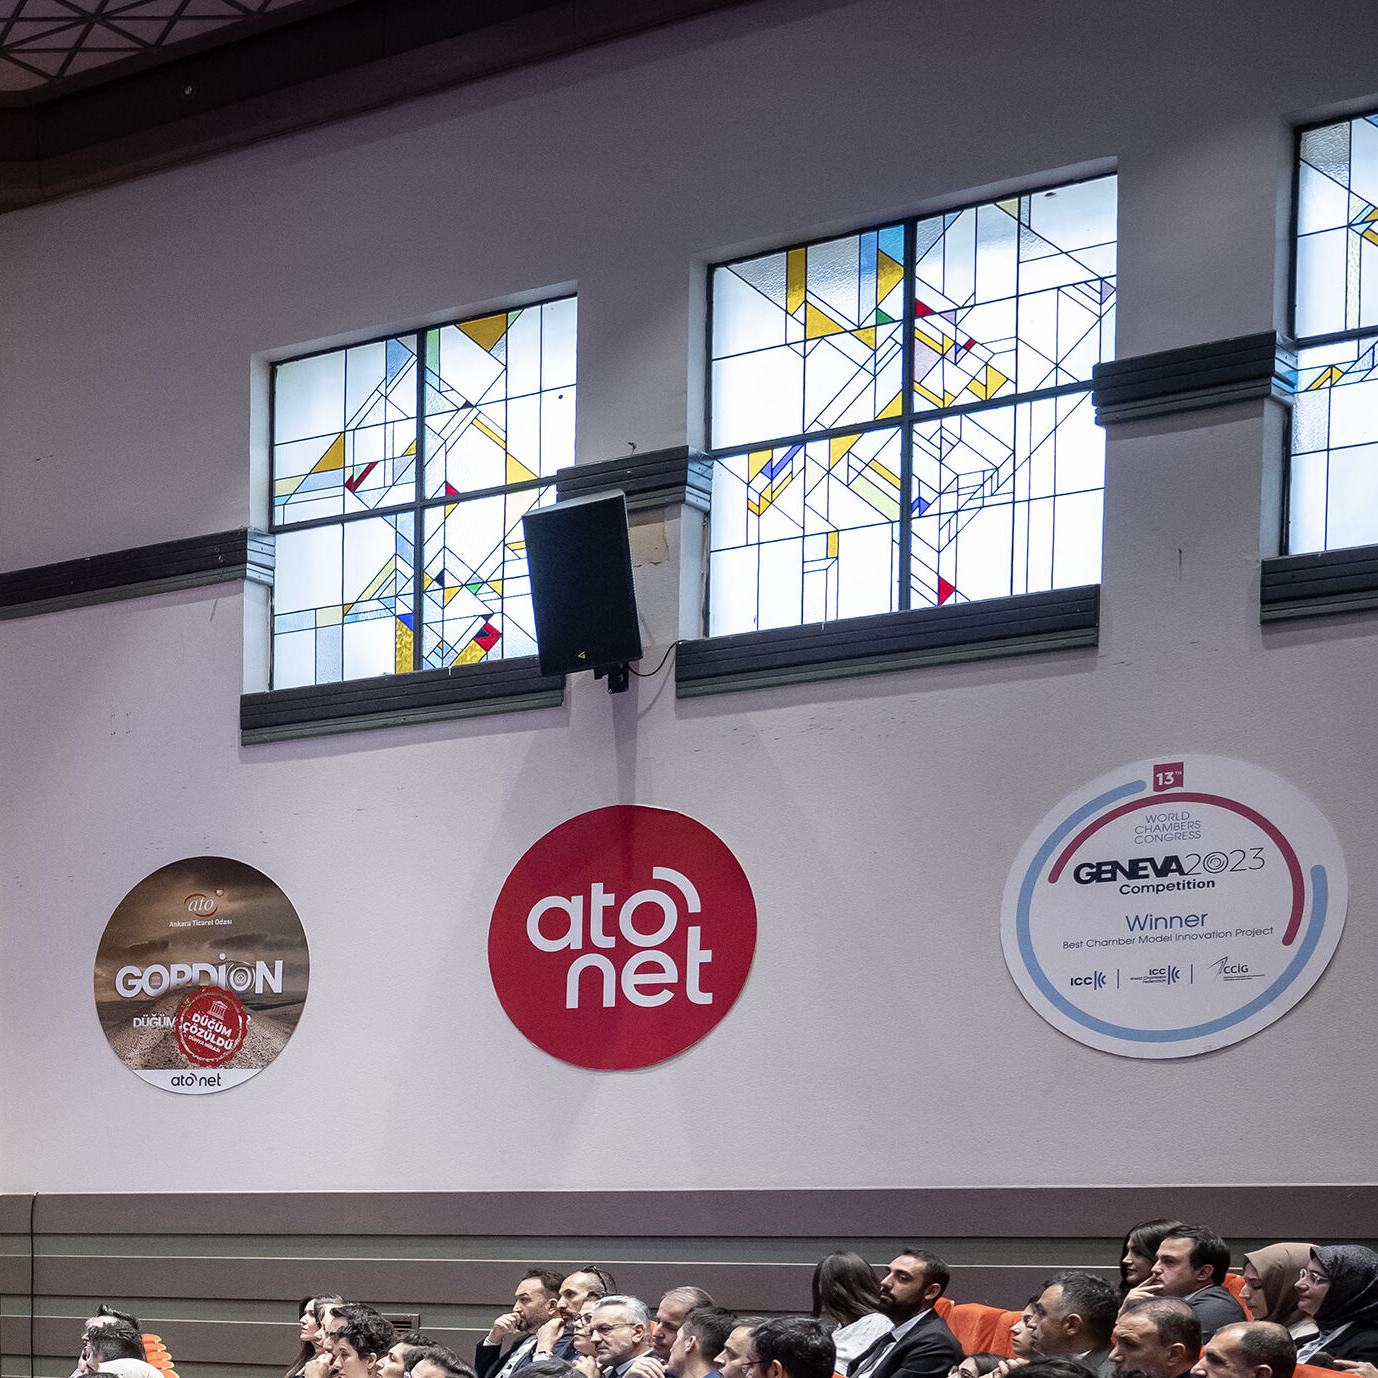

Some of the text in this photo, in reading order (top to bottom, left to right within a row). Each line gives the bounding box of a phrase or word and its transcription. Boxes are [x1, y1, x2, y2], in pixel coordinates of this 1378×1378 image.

[1145, 811, 1190, 824] WORLD
[1134, 820, 1201, 835] CHAMBERS
[1134, 830, 1201, 845] CONGRESS
[1119, 879, 1216, 895] Competition
[188, 898, 214, 912] ato
[527, 882, 678, 952] ato
[1125, 912, 1209, 932] Winner
[1063, 926, 1274, 949] Best Chamber Model Innovation Project
[566, 926, 713, 1009] net
[1149, 967, 1166, 975] ICC
[1070, 976, 1093, 986] ICC
[192, 1012, 233, 1038] DÜĞÜM
[182, 1022, 234, 1050] ÇÖZÜLDÜ
